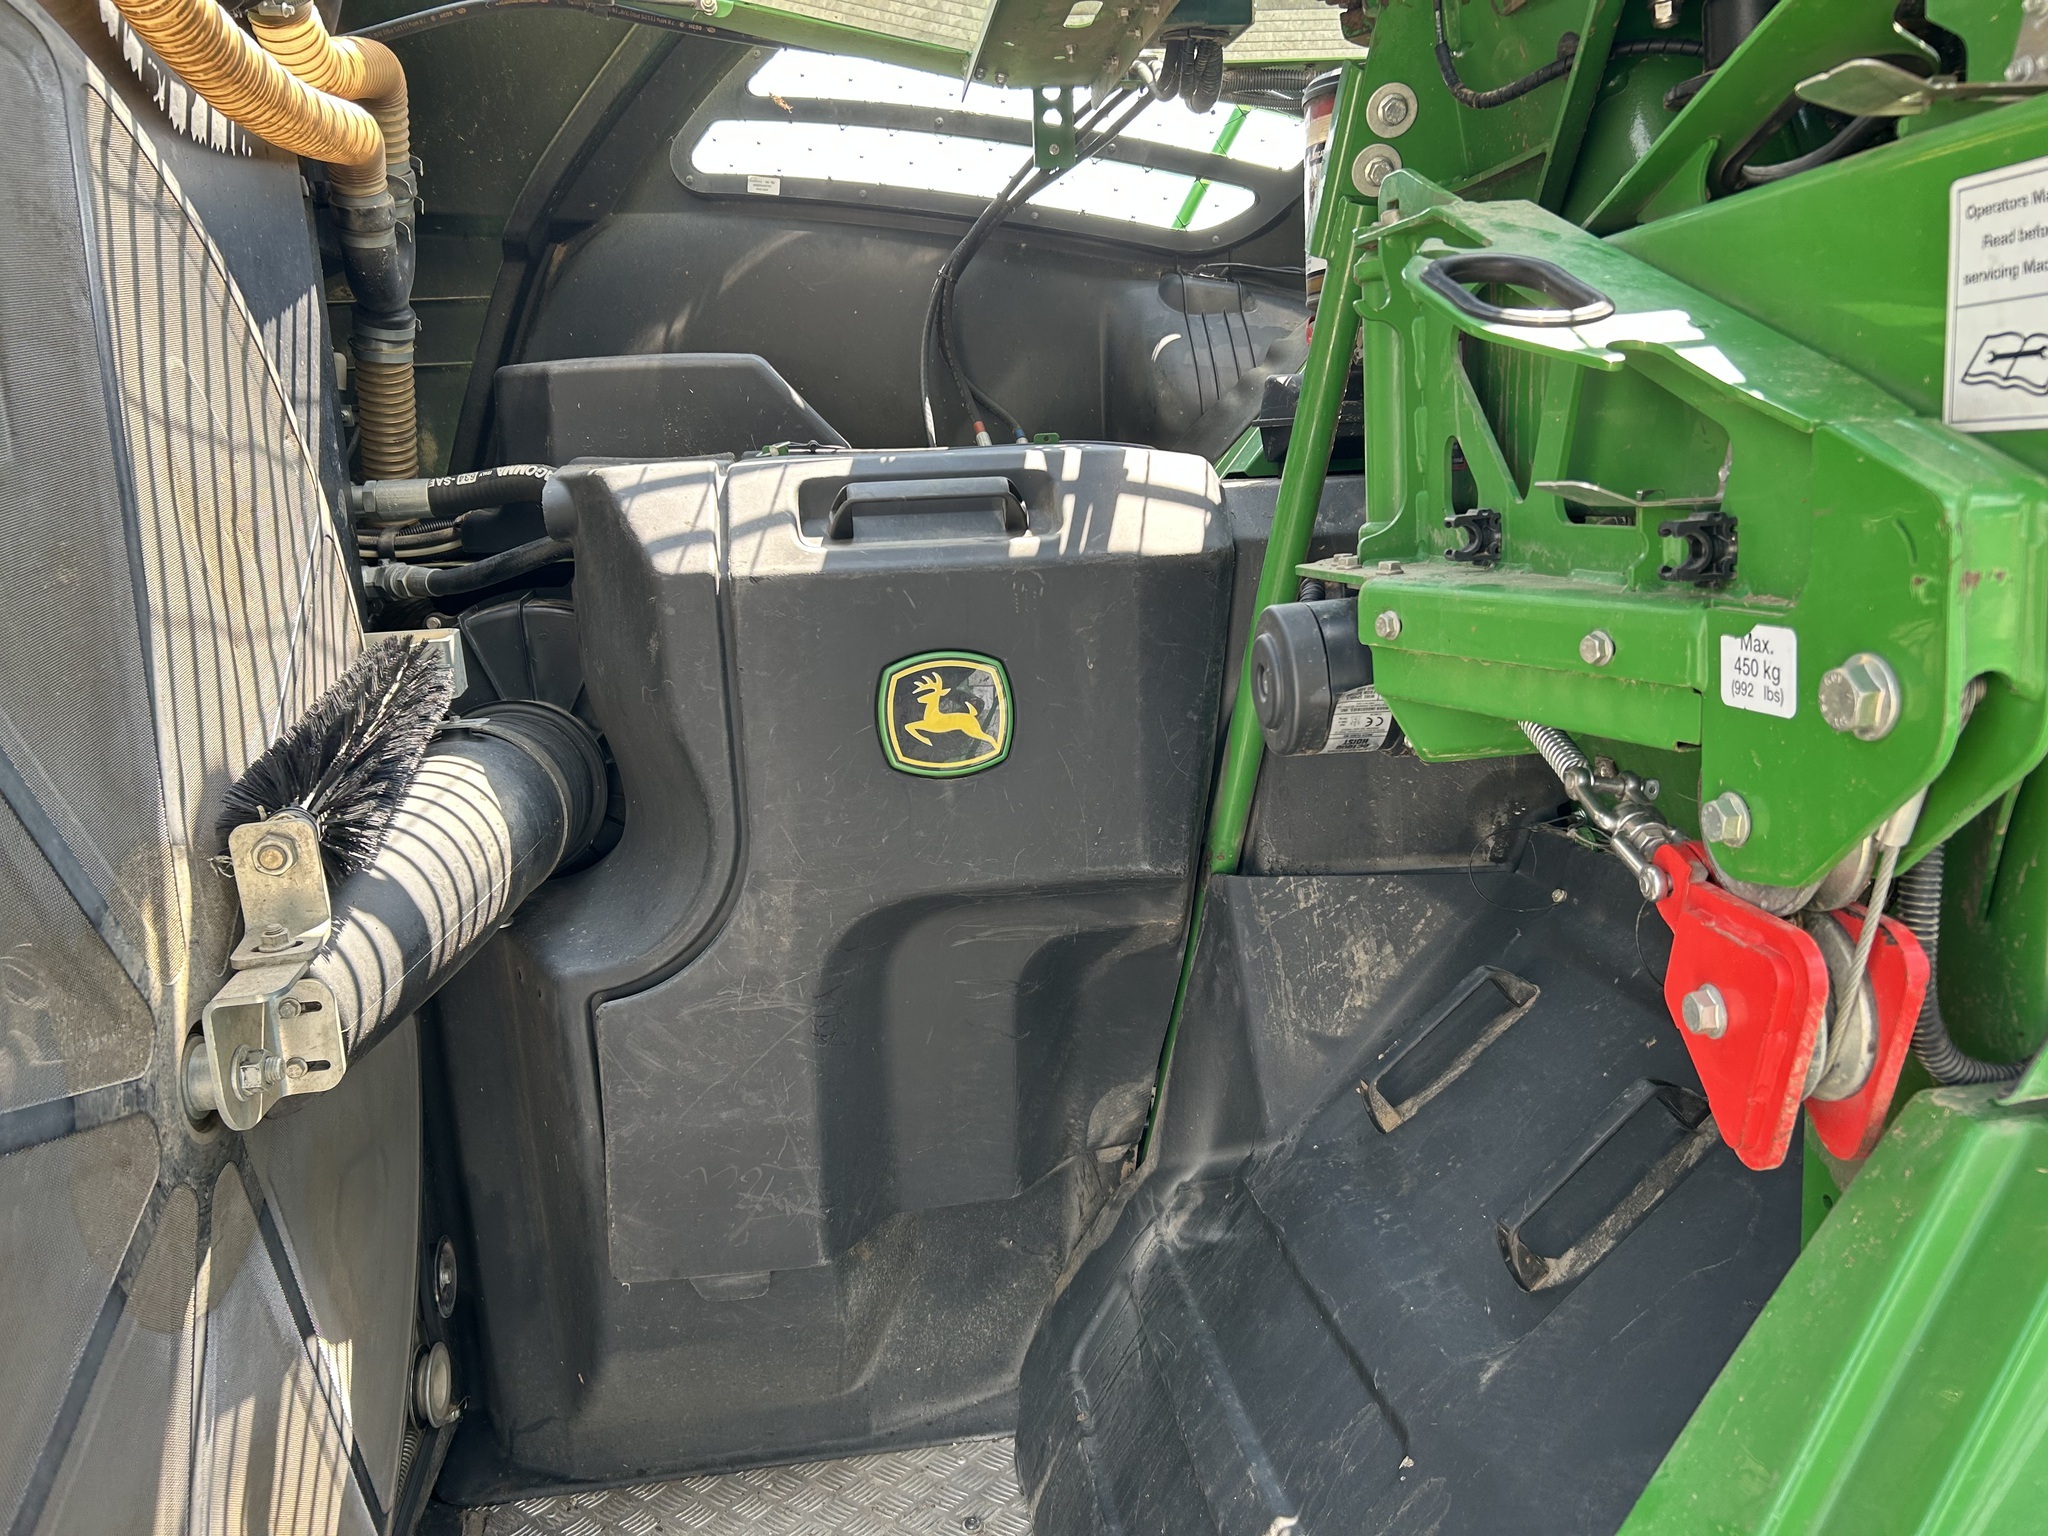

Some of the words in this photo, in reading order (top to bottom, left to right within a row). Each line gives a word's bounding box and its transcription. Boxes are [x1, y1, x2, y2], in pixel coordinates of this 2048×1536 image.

[1965, 194, 2029, 222] Operators
[1981, 229, 2015, 249] Read
[1962, 262, 2020, 287] servicing
[1740, 633, 1774, 655] Max.
[1734, 656, 1759, 678] 450
[1763, 660, 1781, 686] kg
[1731, 679, 1754, 698] (992
[1763, 685, 1784, 707] lbs)
[1342, 738, 1369, 746] HOIST
